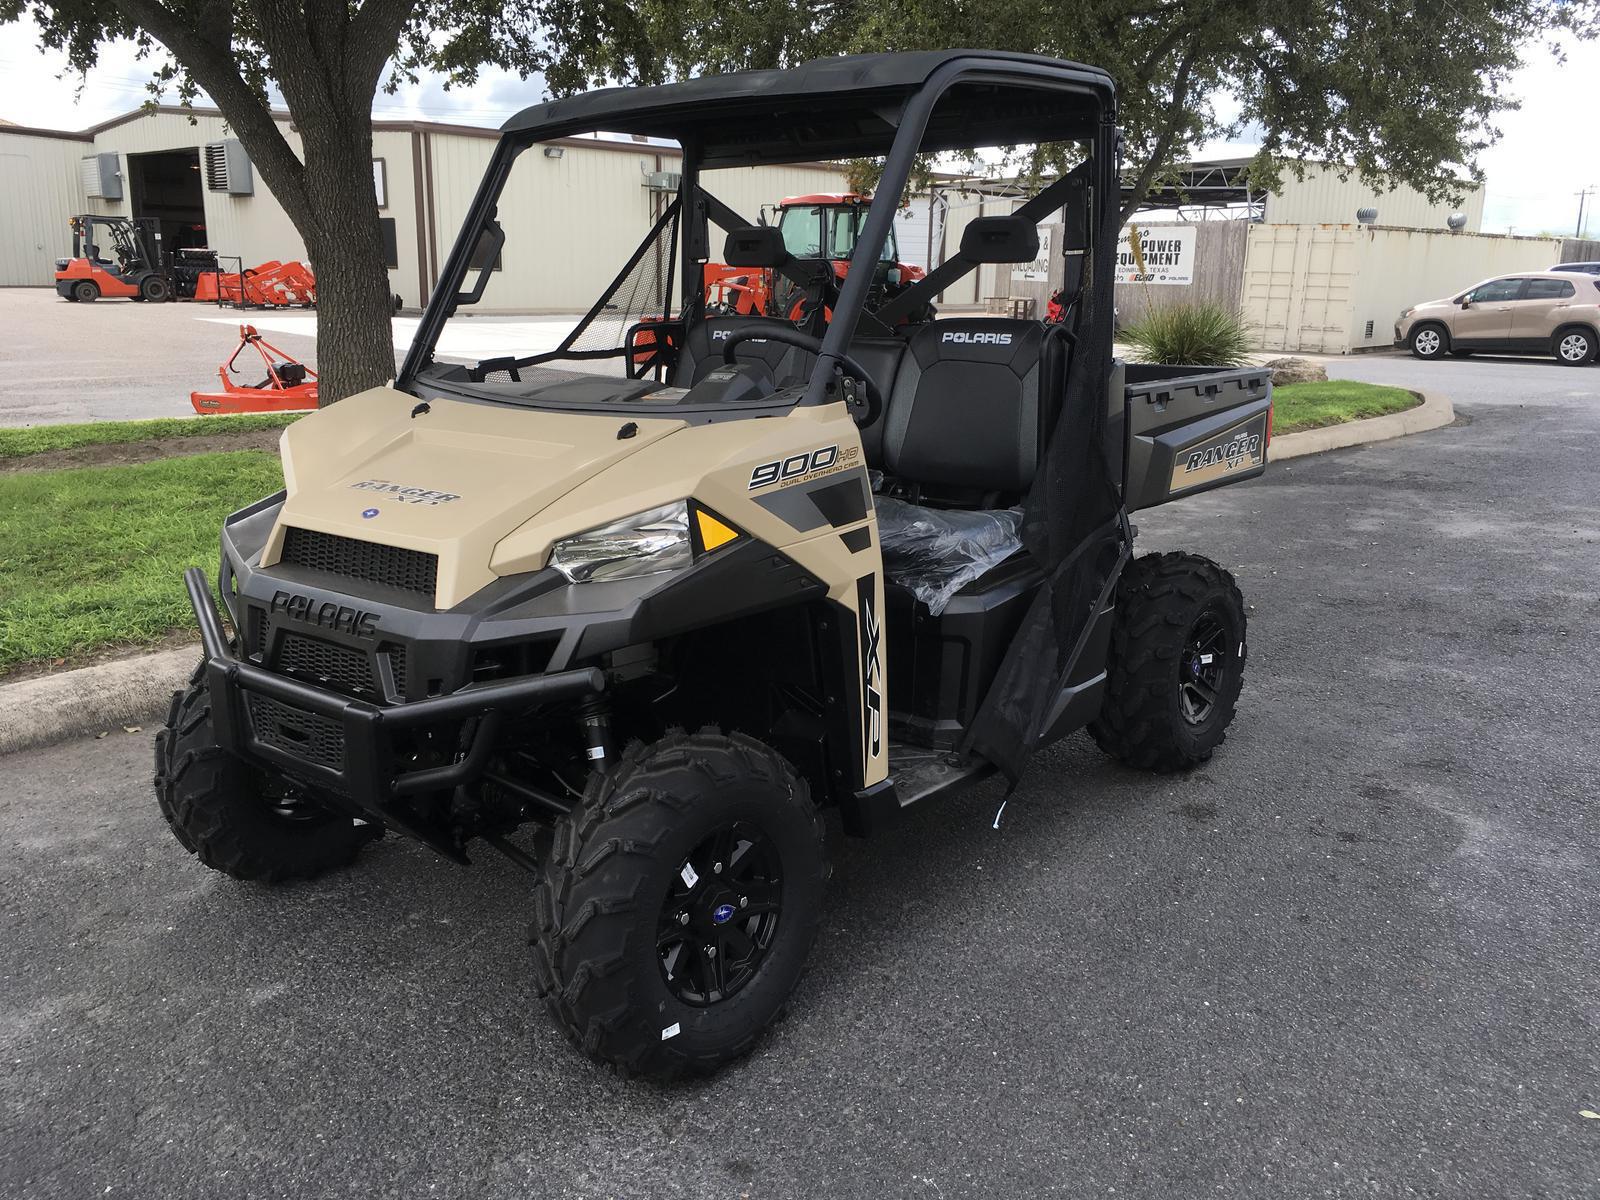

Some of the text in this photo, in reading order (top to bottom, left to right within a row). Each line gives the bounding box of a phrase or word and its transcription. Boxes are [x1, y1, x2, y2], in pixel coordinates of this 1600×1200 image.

[1115, 253, 1181, 266] EQUPMENT
[1141, 240, 1182, 252] POWER
[941, 332, 1013, 345] POLARIS
[747, 444, 839, 491] 900
[1185, 434, 1260, 473] RANGER
[780, 460, 860, 488] DUAL OVERHEAD CAM
[347, 480, 462, 504] RANGER
[270, 590, 381, 641] POLARIS
[866, 598, 881, 758] XP
